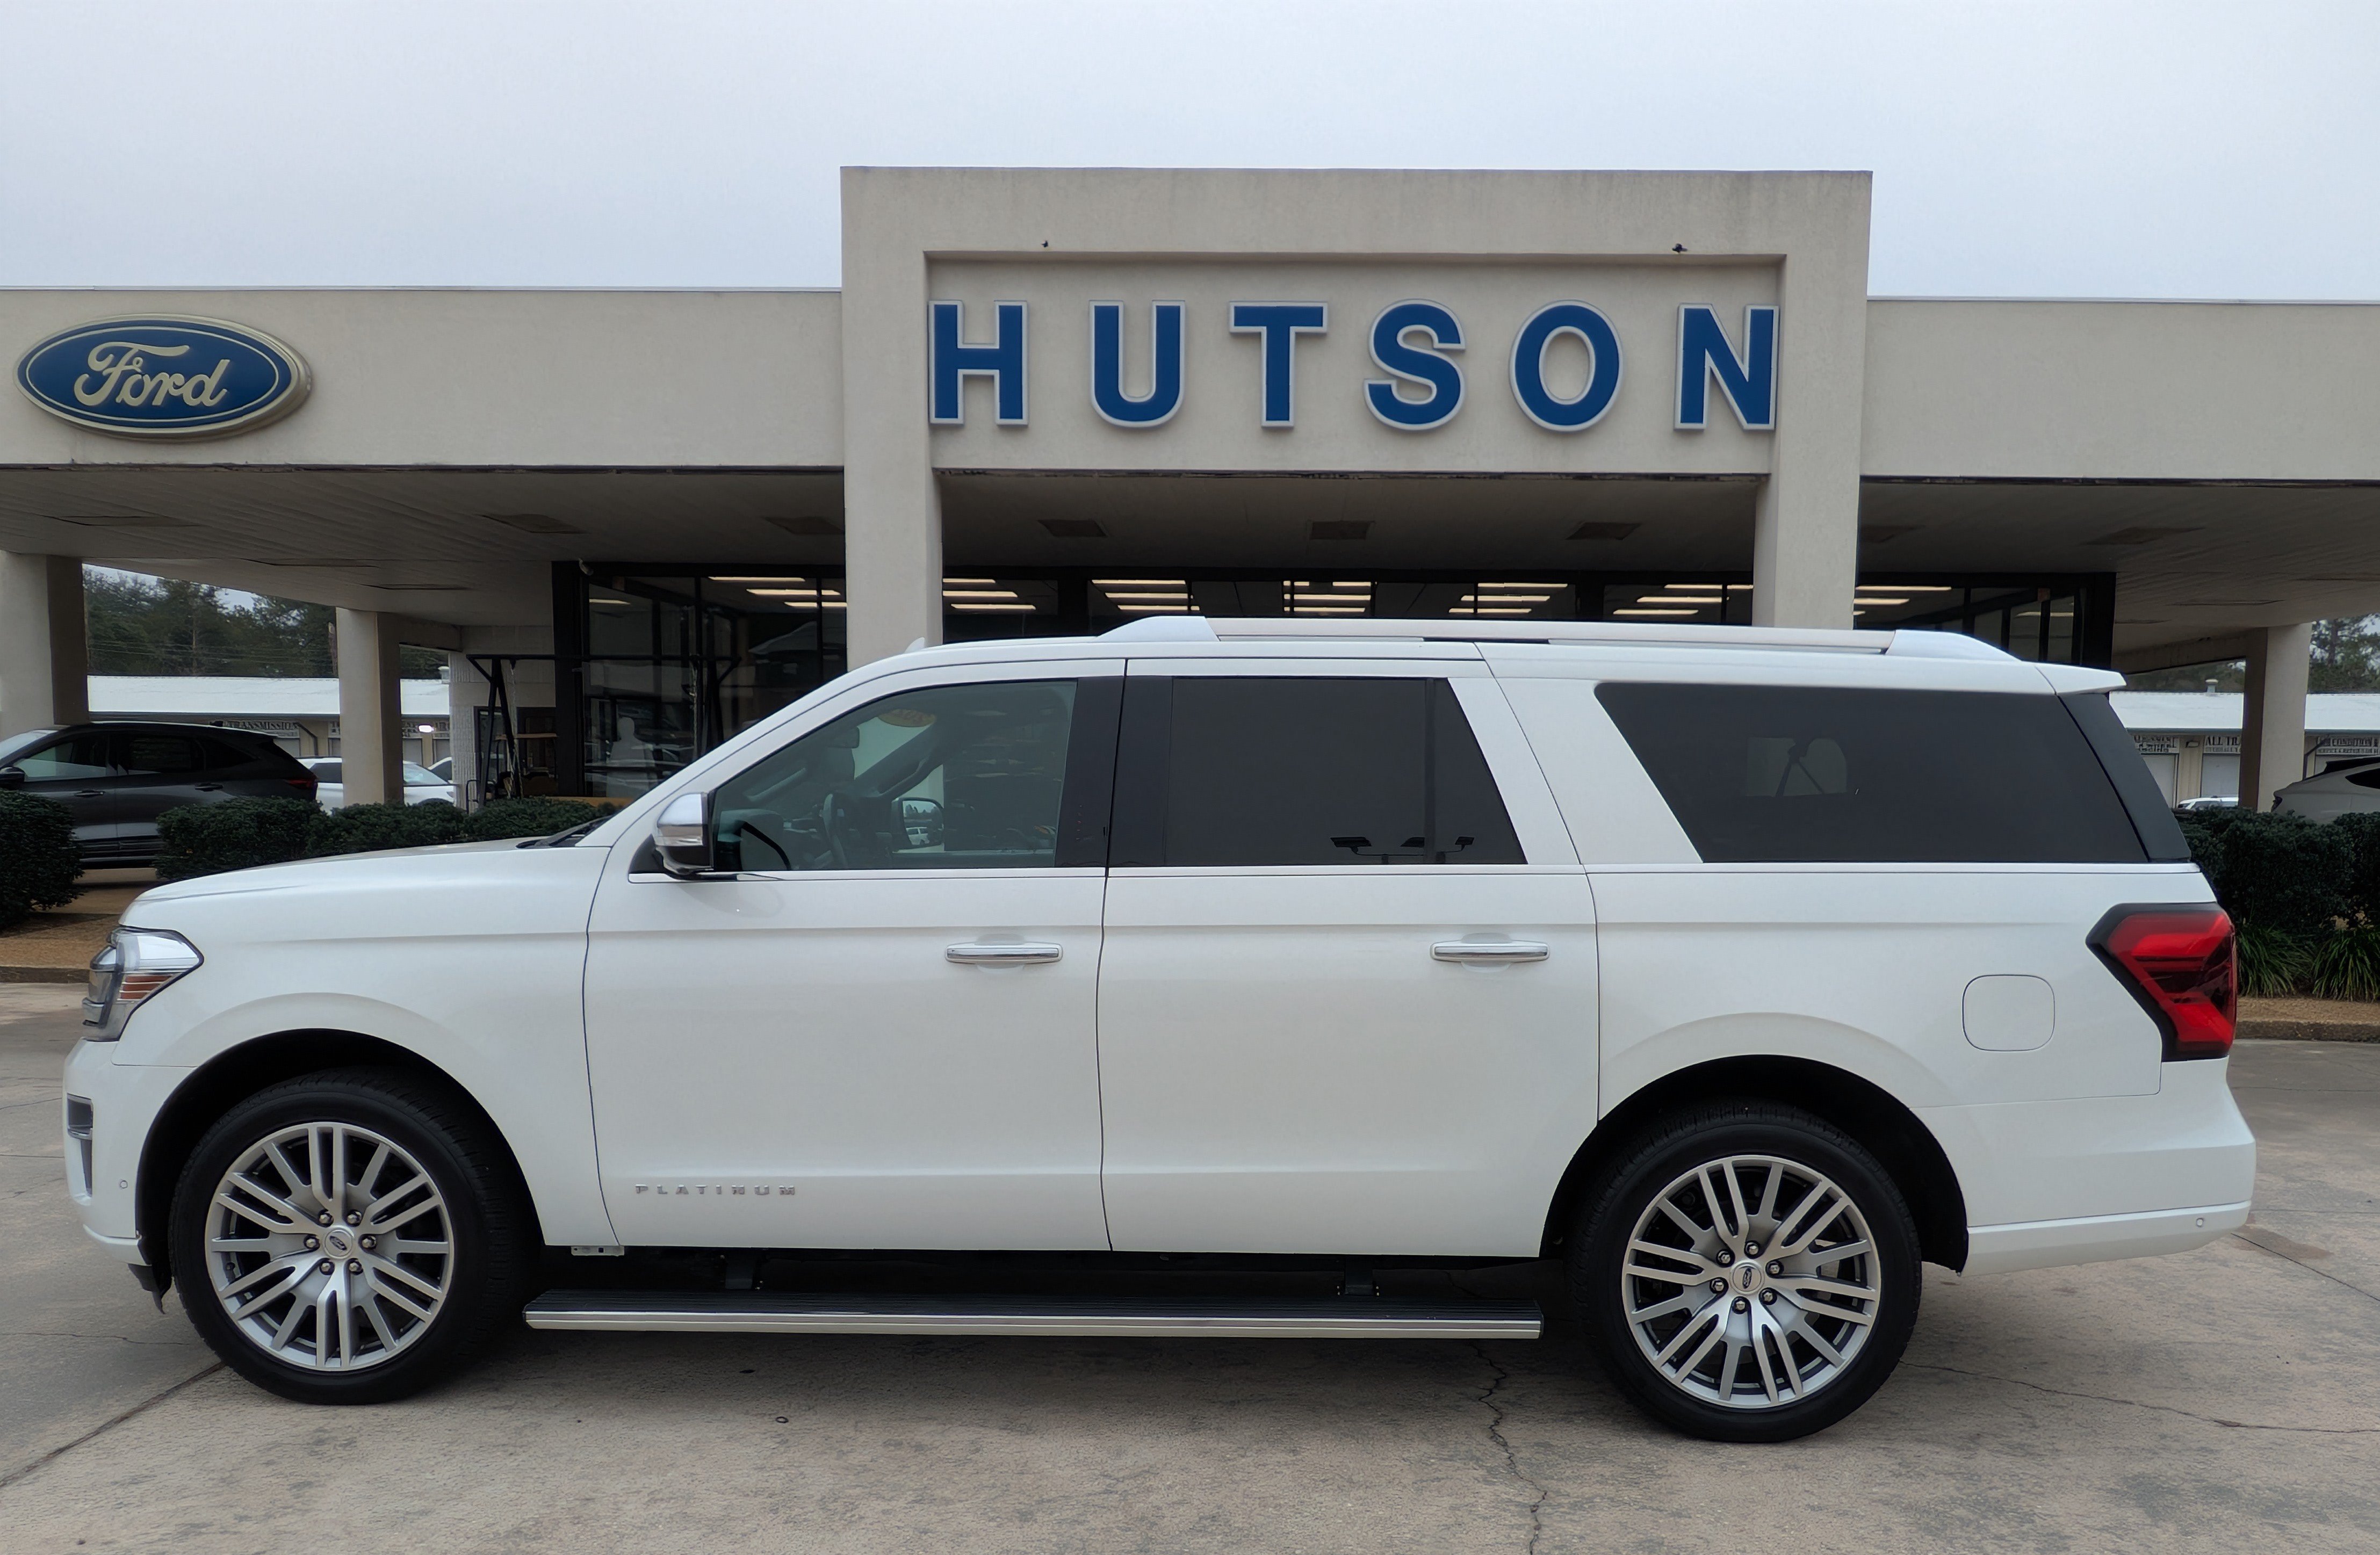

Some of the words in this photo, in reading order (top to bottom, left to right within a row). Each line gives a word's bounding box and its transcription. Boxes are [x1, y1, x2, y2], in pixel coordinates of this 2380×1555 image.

[74, 341, 230, 407] Ford
[928, 299, 1780, 432] HUTSON
[2205, 735, 2223, 746] ALL
[634, 1183, 796, 1196] PLATINUM
